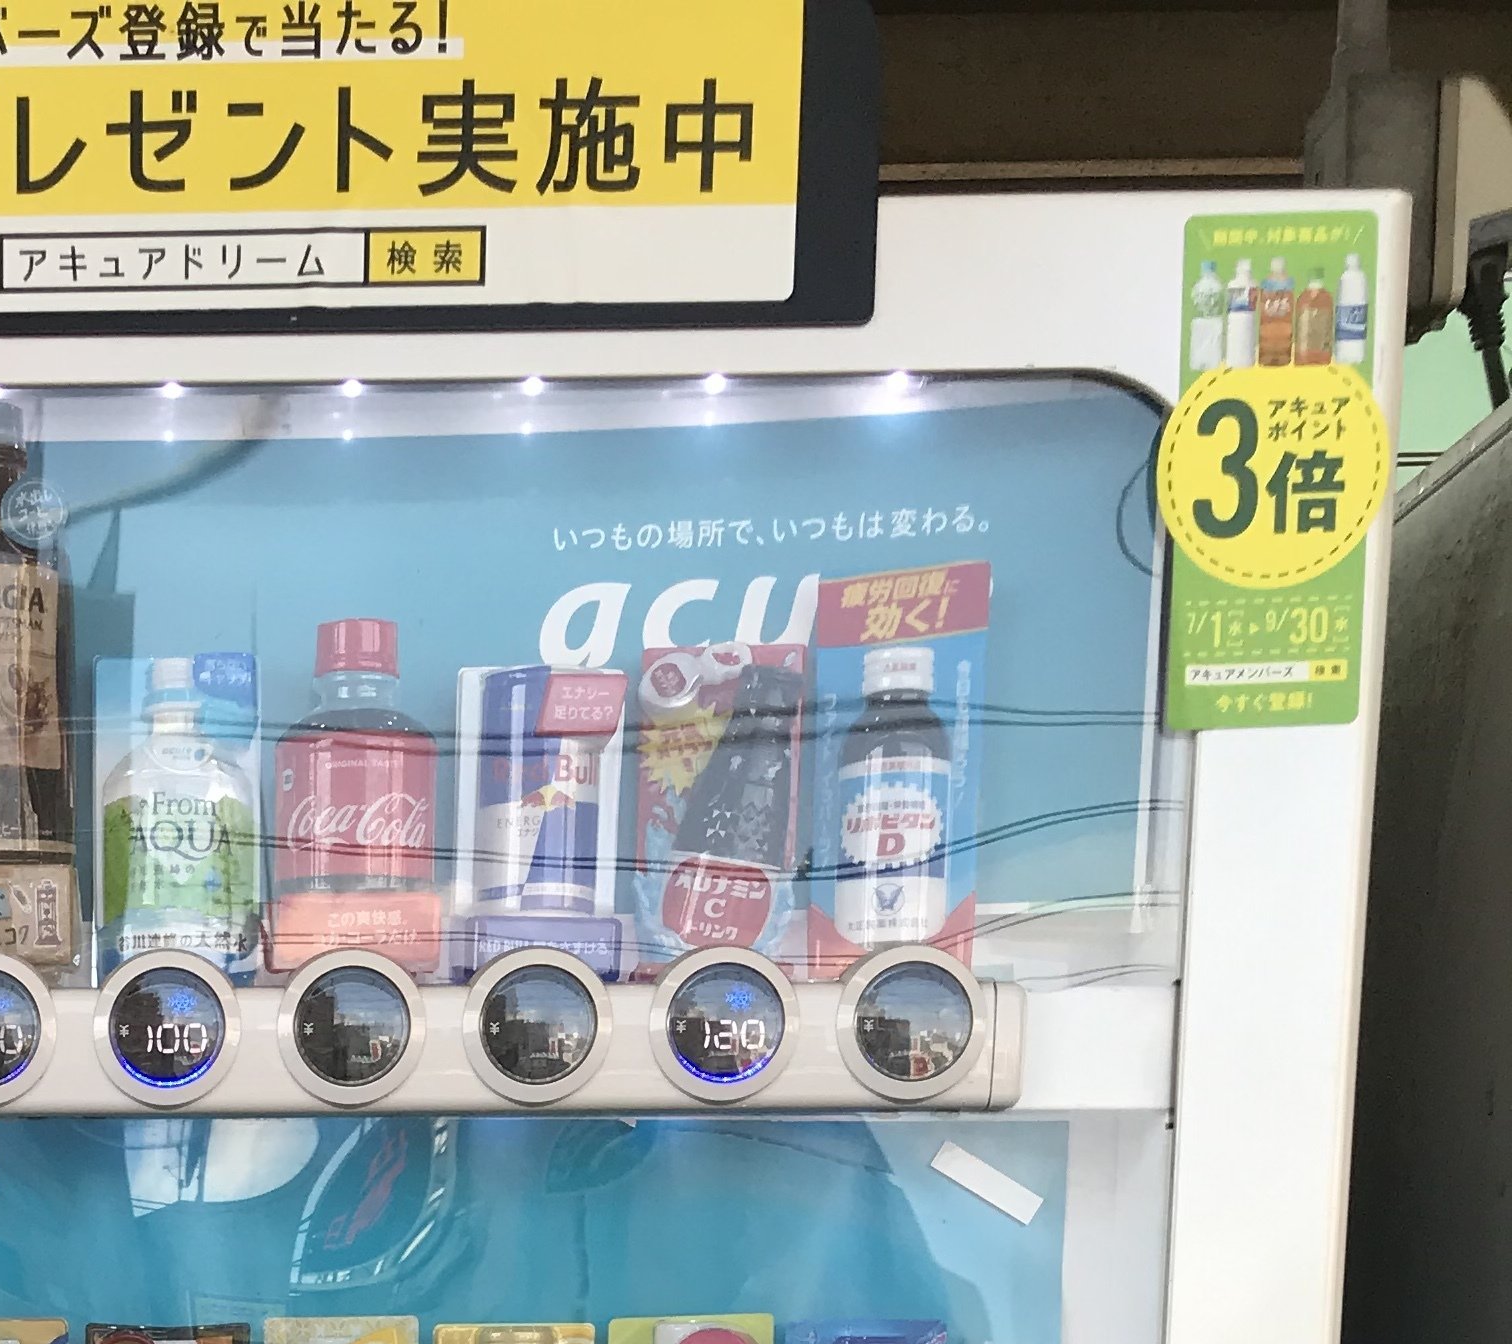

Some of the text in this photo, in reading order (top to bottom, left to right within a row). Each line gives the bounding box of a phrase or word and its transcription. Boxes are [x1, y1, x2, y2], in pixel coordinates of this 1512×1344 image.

[17, 241, 466, 284] アキュアドリーム 検索
[1268, 397, 1351, 419] アキュア
[1268, 421, 1348, 443] ポイント
[553, 505, 990, 552] いつもの場所で、いつもは変わる。
[859, 597, 951, 643] 効く!
[151, 790, 218, 817] From
[287, 791, 430, 853] Coca-Cola
[130, 820, 234, 862] AQUA
[876, 833, 906, 857] D
[703, 898, 726, 919] C
[146, 1021, 209, 1055] 100
